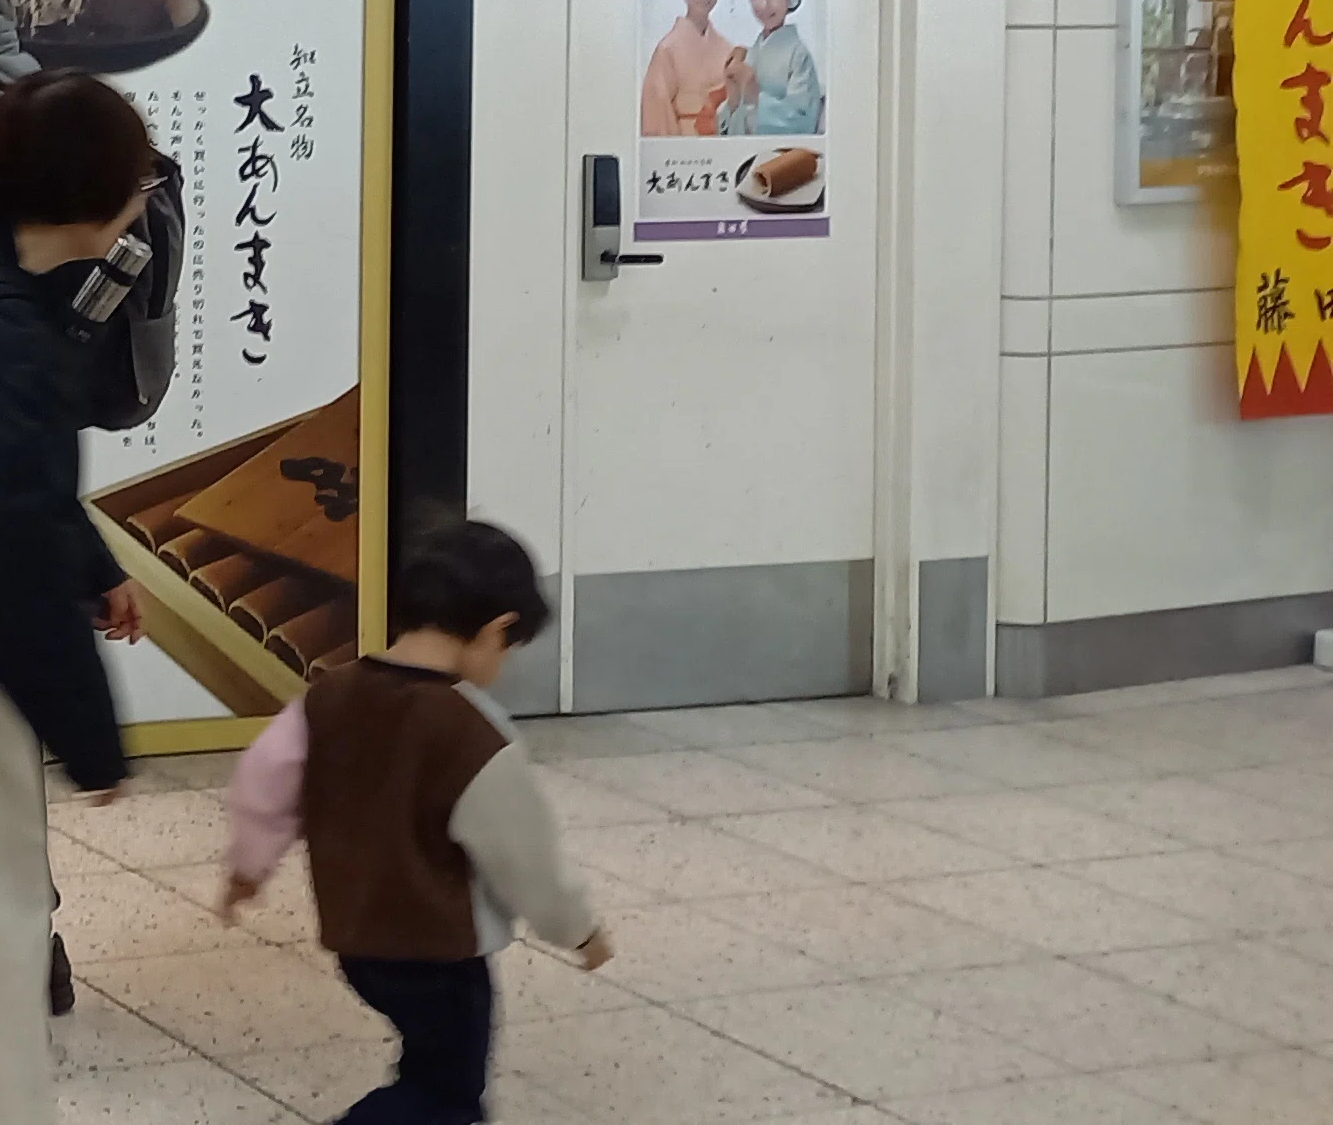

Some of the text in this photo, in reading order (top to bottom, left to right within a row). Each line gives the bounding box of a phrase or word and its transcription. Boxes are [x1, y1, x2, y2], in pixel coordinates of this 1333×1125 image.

[289, 43, 317, 161] 知立名物
[230, 73, 285, 365] 大あんまき
